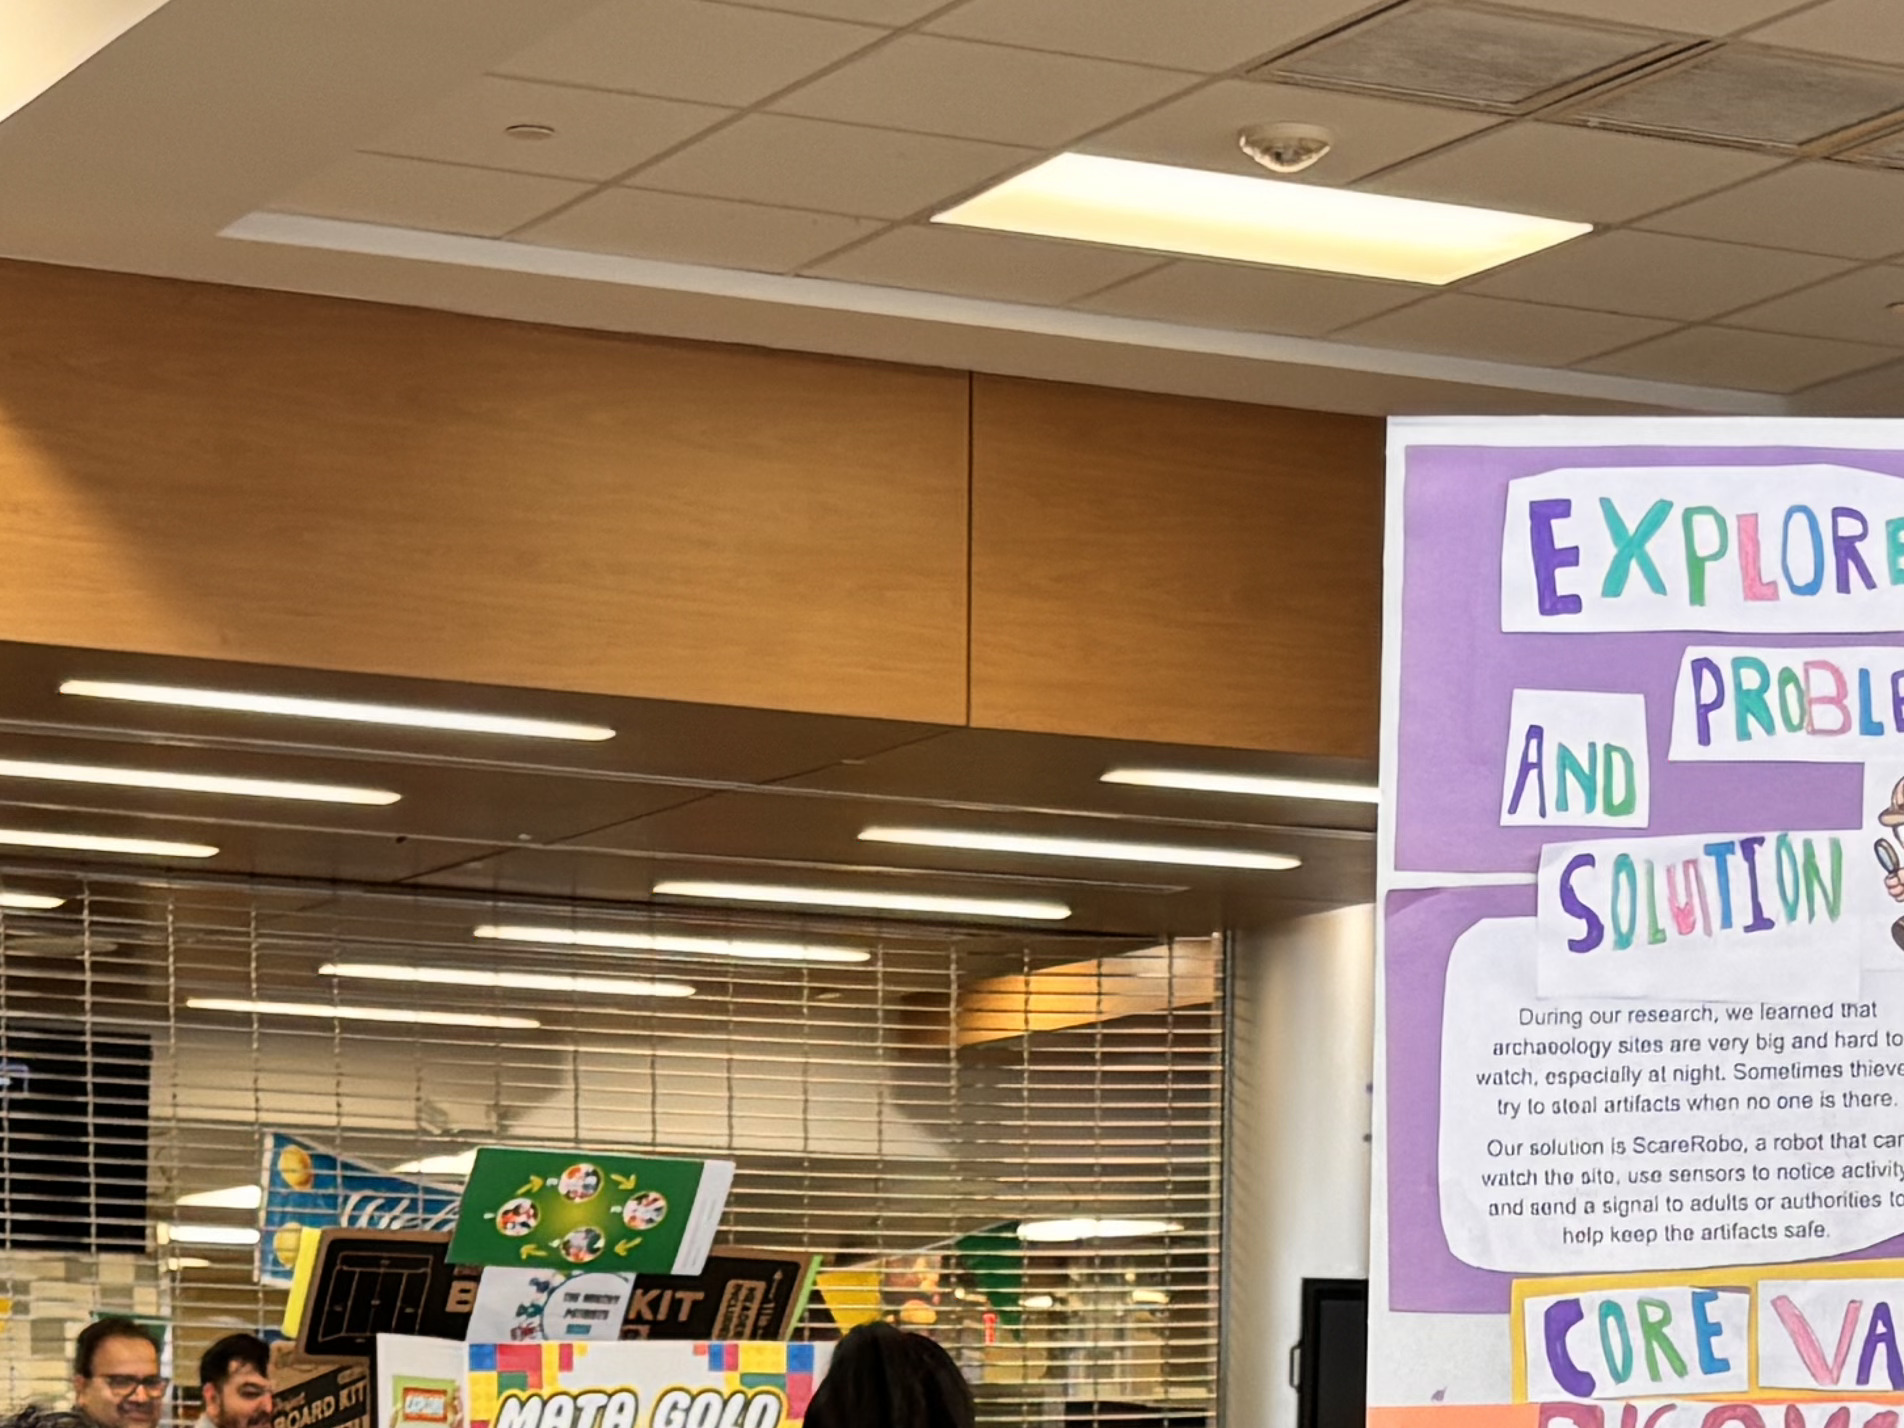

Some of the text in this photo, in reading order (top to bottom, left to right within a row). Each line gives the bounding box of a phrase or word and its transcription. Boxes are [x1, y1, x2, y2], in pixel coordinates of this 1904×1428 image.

[1508, 724, 1635, 817] AND
[1559, 834, 1843, 954] SOLUTION
[1519, 1003, 1877, 1029] During our research, we learned that
[1493, 1031, 1903, 1059] archaeology sites are very big and hard to
[1476, 1068, 1537, 1086] watch,
[1545, 1066, 1642, 1087] especially
[1648, 1068, 1666, 1083] at
[1673, 1065, 1726, 1086] night.
[1733, 1062, 1843, 1081] Sometimes
[1497, 1099, 1520, 1119] try
[1528, 1098, 1544, 1115] to
[1604, 1095, 1680, 1113] artifacts
[1686, 1095, 1739, 1111] when
[1747, 1096, 1769, 1110] no
[1777, 1095, 1813, 1109] one
[1820, 1092, 1835, 1108] is
[1843, 1091, 1898, 1107] there.
[1487, 1139, 1523, 1157] Our
[1530, 1138, 1603, 1156] solution
[1611, 1138, 1626, 1154] is
[1633, 1135, 1748, 1154] ScareRobo,
[1755, 1138, 1766, 1151] a
[1774, 1134, 1823, 1151] robot
[1830, 1133, 1867, 1149] that
[1482, 1169, 1537, 1186] watch
[1544, 1169, 1573, 1184] the
[1627, 1170, 1662, 1184] use
[1669, 1167, 1745, 1182] sensors
[1752, 1165, 1769, 1180] to
[1777, 1164, 1834, 1180] notice
[1489, 1199, 1523, 1216] and
[1530, 1198, 1577, 1215] send
[1584, 1201, 1595, 1214] a
[1603, 1195, 1659, 1216] signal
[1666, 1195, 1683, 1212] to
[1690, 1194, 1748, 1211] adults
[1755, 1196, 1774, 1209] or
[1781, 1191, 1881, 1209] authorities
[1563, 1222, 1829, 1246] help keep the artifacts safe.
[629, 1289, 704, 1323] KIT
[1544, 1289, 1728, 1397] CORE
[339, 1382, 367, 1410] KIT
